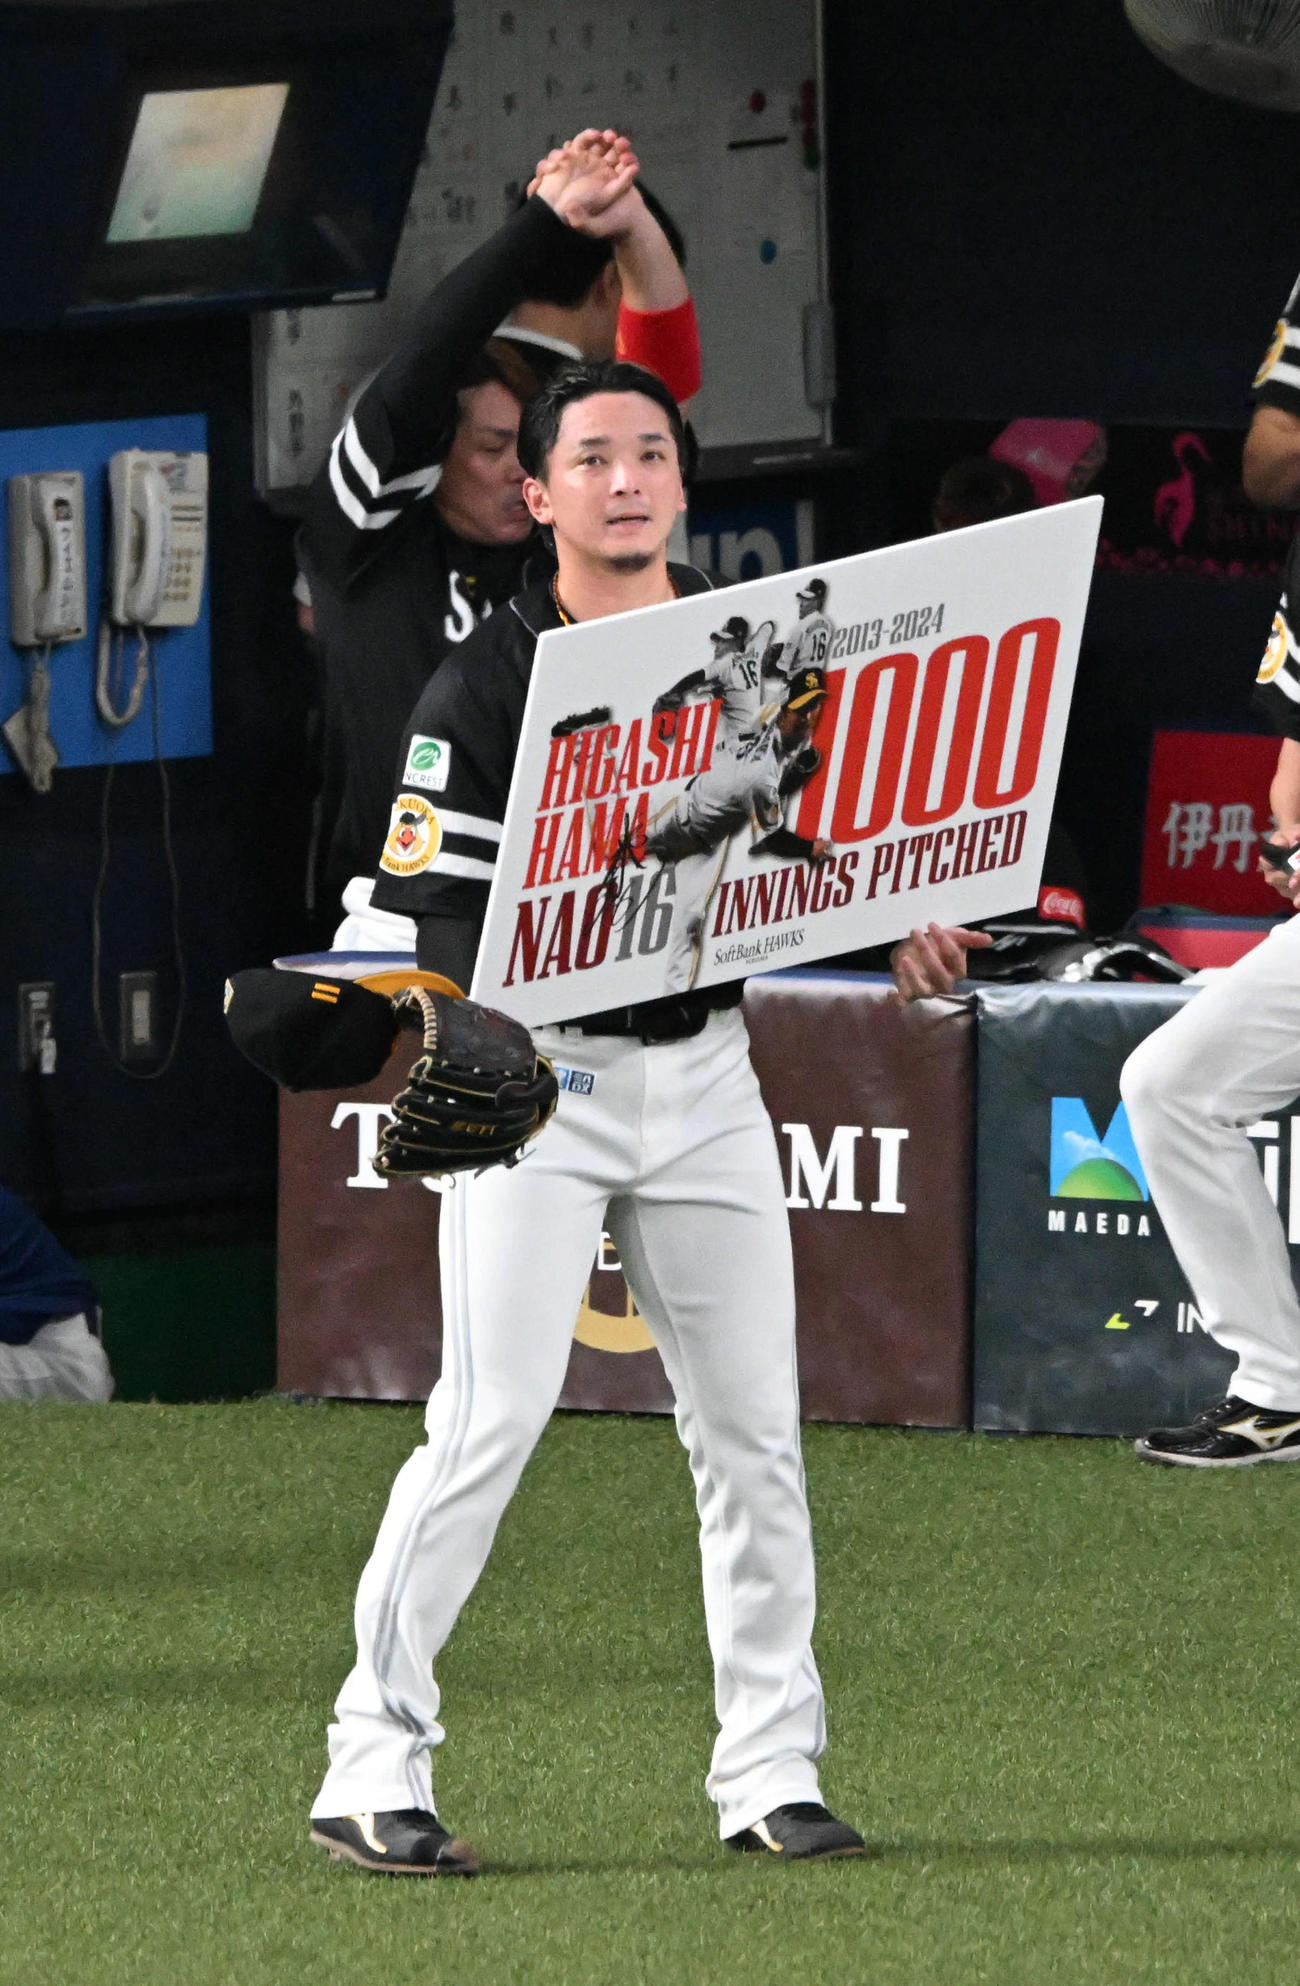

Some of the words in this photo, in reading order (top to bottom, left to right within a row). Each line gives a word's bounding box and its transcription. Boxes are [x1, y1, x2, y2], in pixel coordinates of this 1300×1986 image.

[832, 603, 945, 659] 2013-2024
[537, 697, 724, 812] HIGASHI
[796, 617, 1060, 844] 1000
[522, 792, 649, 889] HAMA
[711, 850, 859, 937] INNINGS
[865, 810, 1028, 900] PITCHED
[1162, 802, 1276, 872] 伊丹
[502, 881, 618, 987] NAO
[614, 865, 676, 962] 16
[714, 938, 762, 966] SoftBank
[763, 928, 805, 954] HAWKS
[1048, 1210, 1152, 1238] MAEDA
